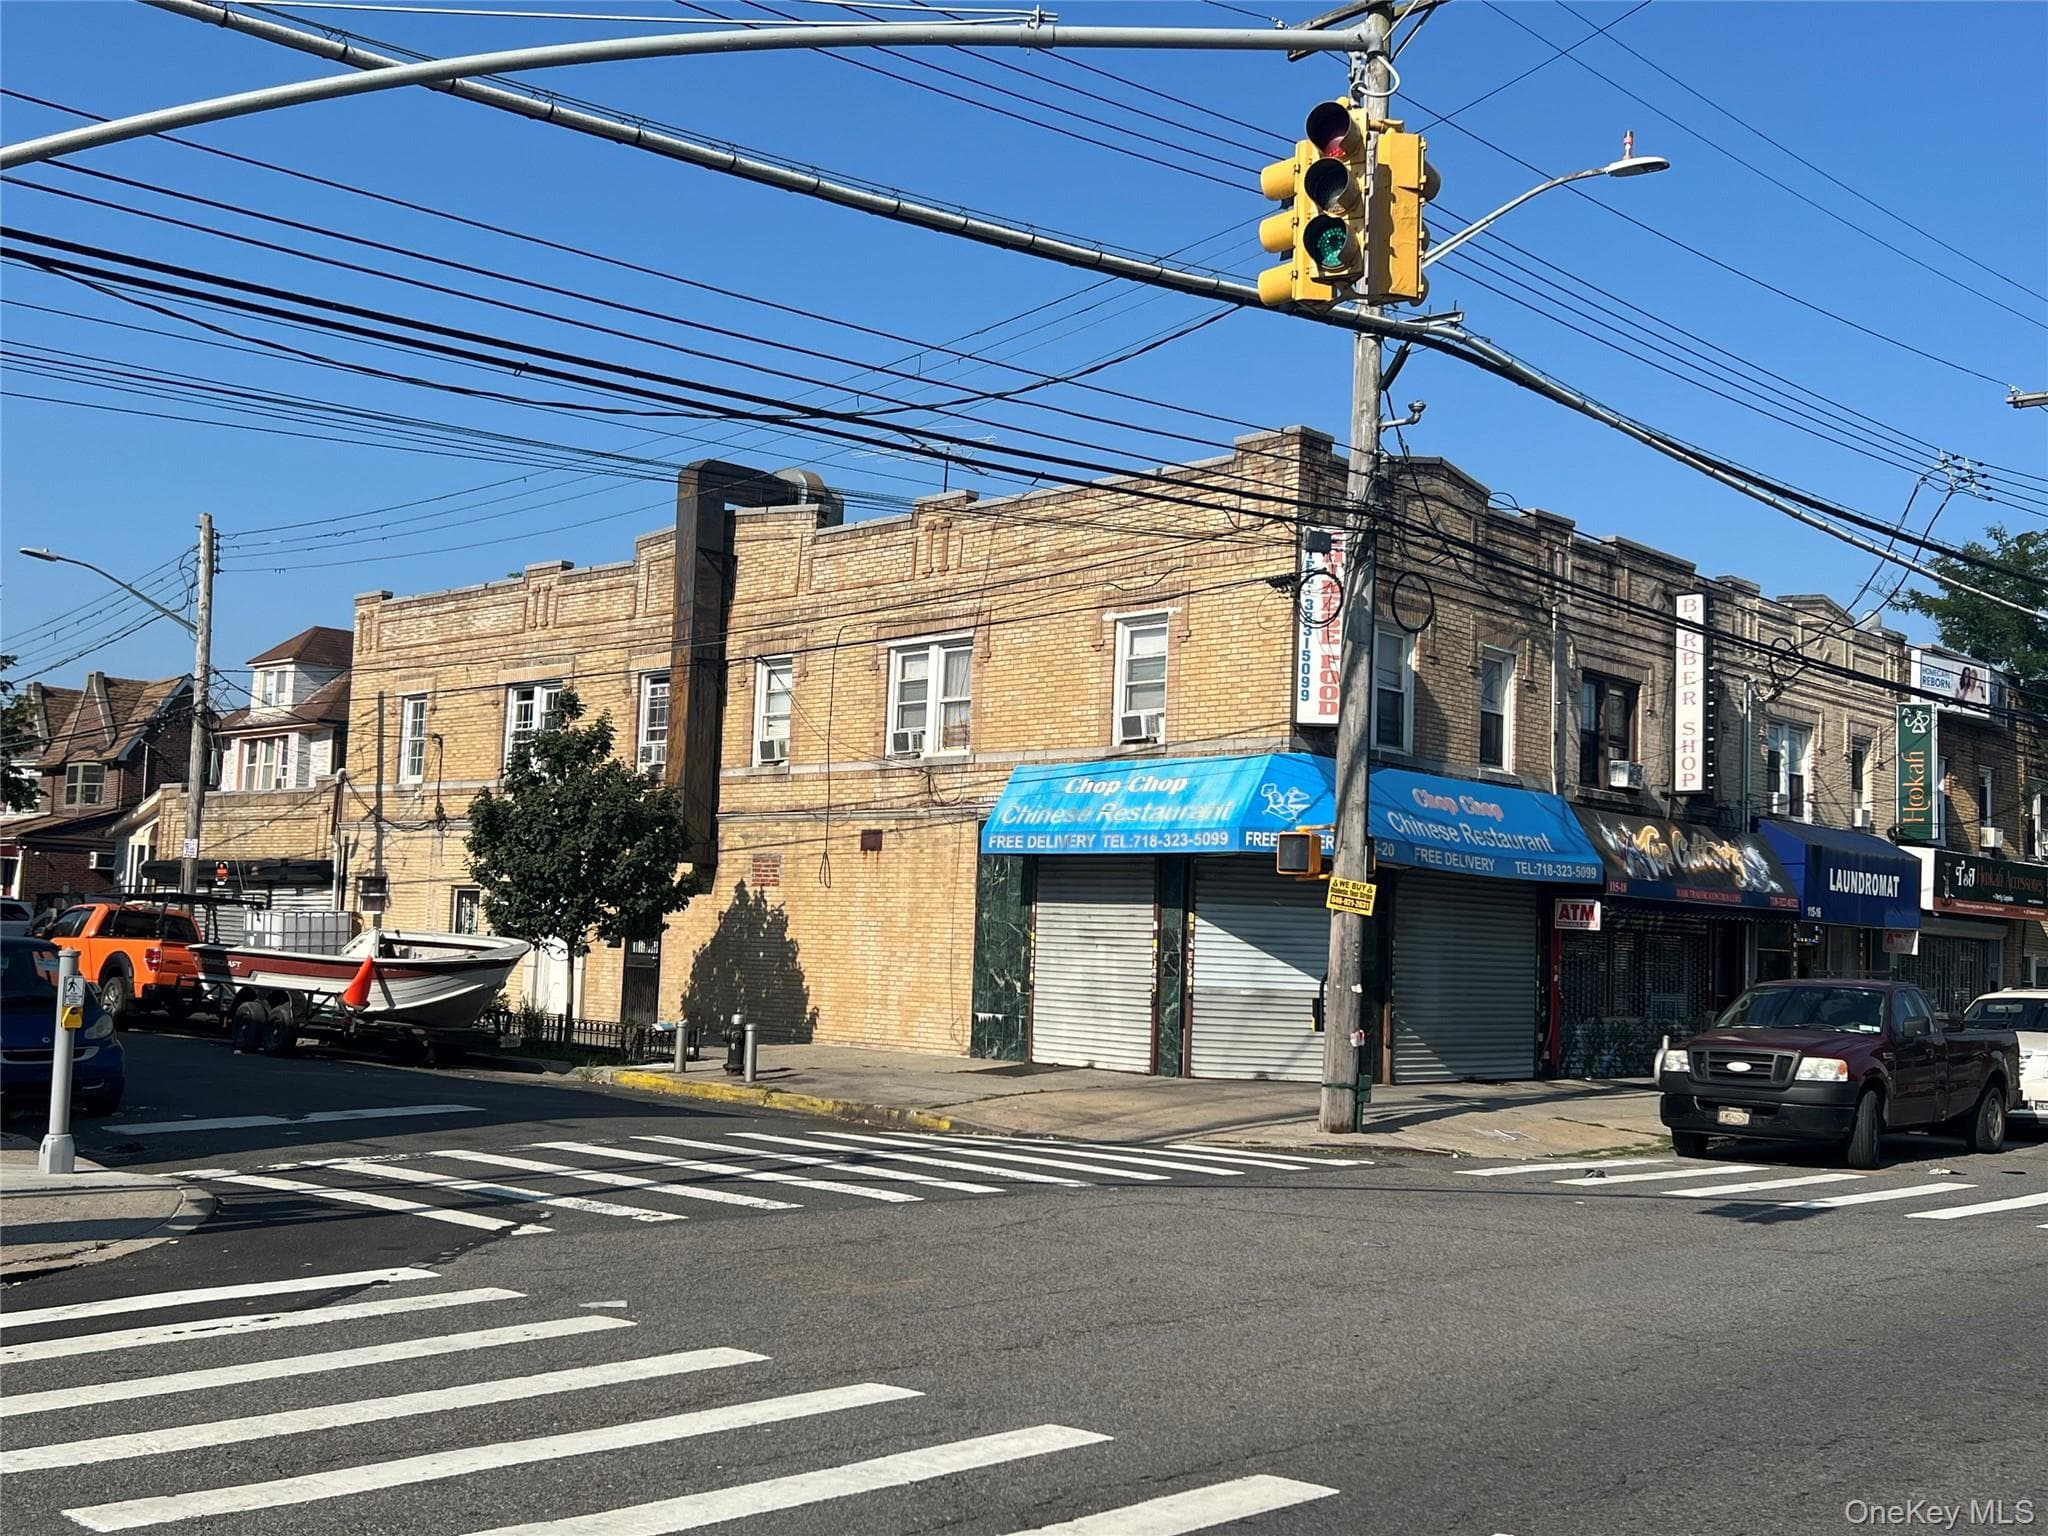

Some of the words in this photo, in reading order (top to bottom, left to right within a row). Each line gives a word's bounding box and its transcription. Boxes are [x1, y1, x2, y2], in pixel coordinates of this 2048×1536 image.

[1319, 655, 1341, 715] FOOD
[1922, 676, 1951, 689] REBORN
[1681, 721, 1696, 787] SHOP
[1065, 777, 1121, 796] Chop
[1128, 775, 1188, 795] Chop
[1901, 751, 1931, 822] Hookah
[1002, 803, 1092, 824] Chinese
[1096, 800, 1233, 822] Restaurant
[1412, 788, 1458, 815] Chop
[1459, 795, 1504, 822] Chop
[989, 835, 1023, 849] FREE
[1027, 834, 1096, 849] DELIVERY
[1245, 831, 1278, 847] FREE
[1387, 811, 1460, 842] Chinese
[1459, 822, 1555, 852] Restaurant
[1414, 847, 1442, 865] FREE
[1445, 852, 1495, 872] DELIVERY
[1514, 861, 1596, 879] TEL:718-323-5099
[1340, 880, 1350, 888] WE
[1352, 882, 1367, 890] BUY
[1829, 867, 1900, 898] LAUNDROMAT
[1559, 903, 1595, 921] ATM
